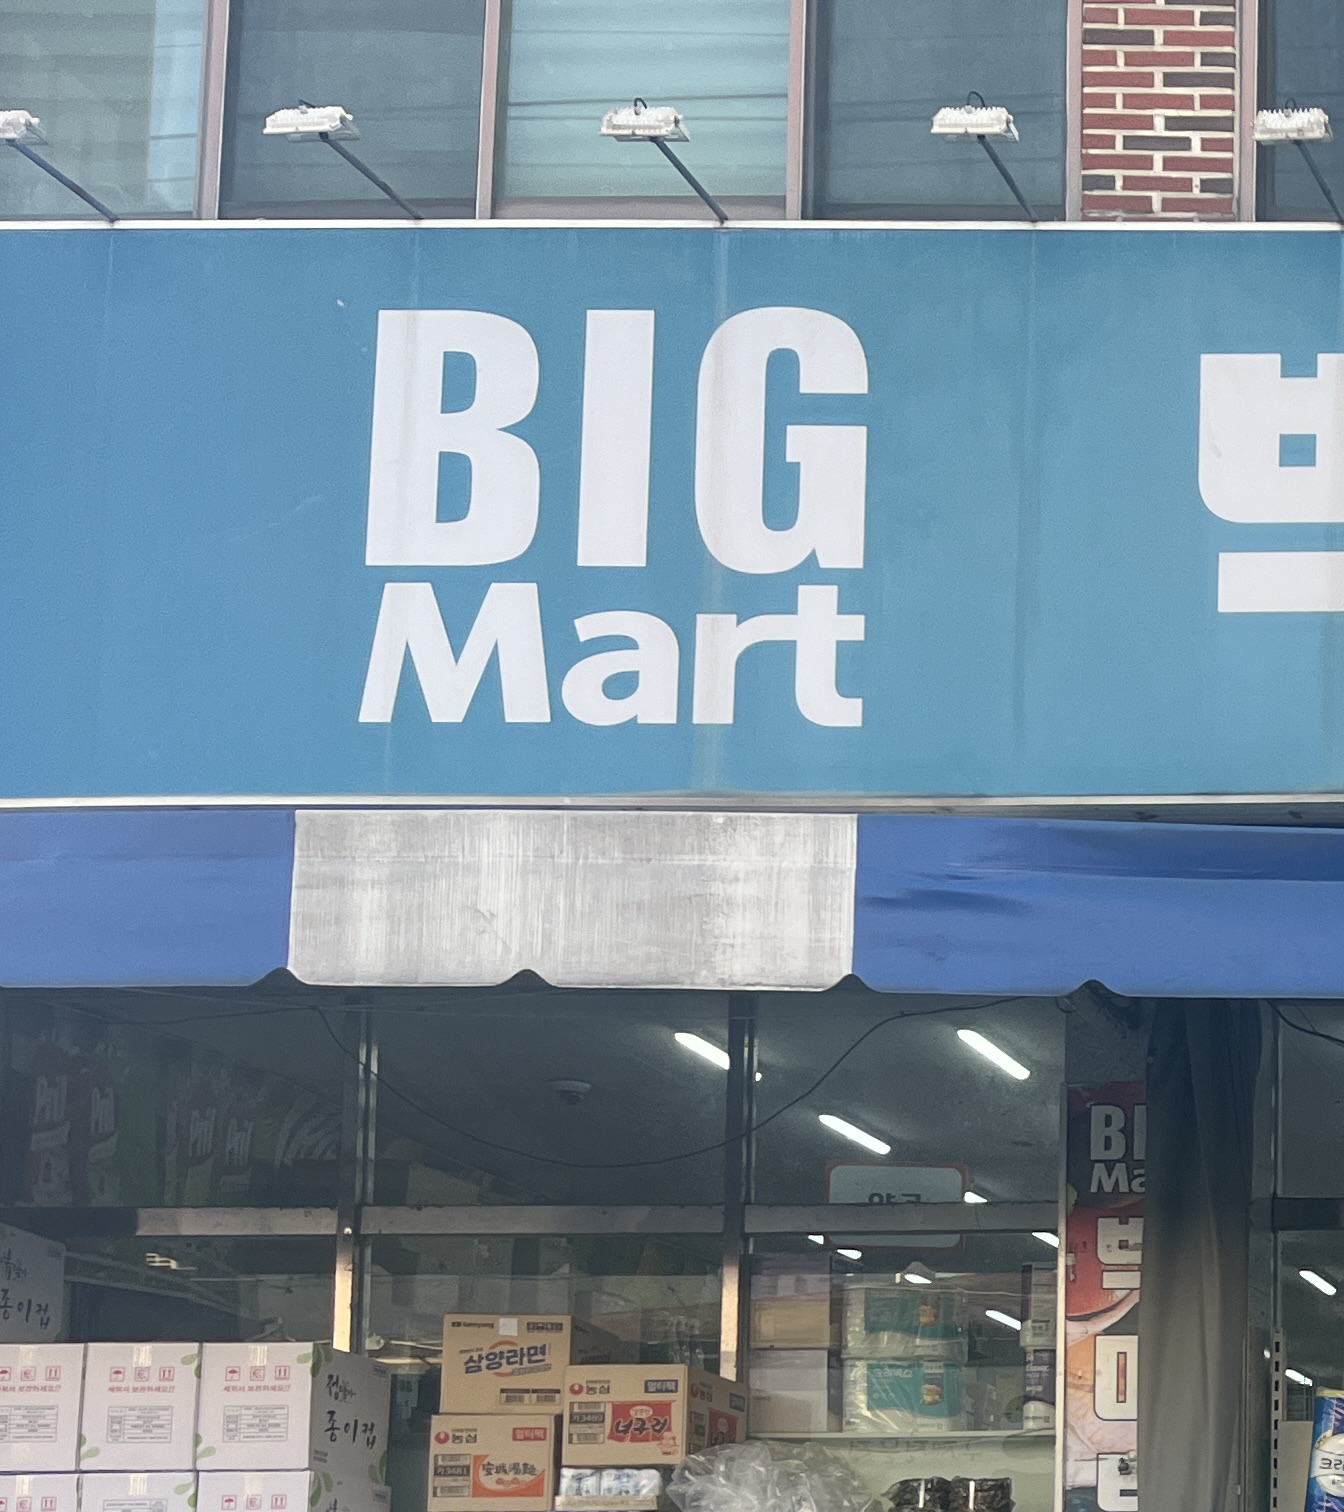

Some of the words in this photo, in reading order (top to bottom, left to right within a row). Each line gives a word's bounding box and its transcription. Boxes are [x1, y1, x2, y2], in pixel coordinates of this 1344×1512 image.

[365, 304, 871, 574] BIG
[359, 583, 865, 728] Mart
[1090, 1105, 1147, 1160] BI
[1090, 1163, 1146, 1193] Ma
[464, 1343, 546, 1374] 삼양라면
[585, 1384, 610, 1395] 농심
[324, 1410, 376, 1449] 종이컵
[451, 1433, 478, 1444] 농심
[614, 1417, 668, 1436] 너구리
